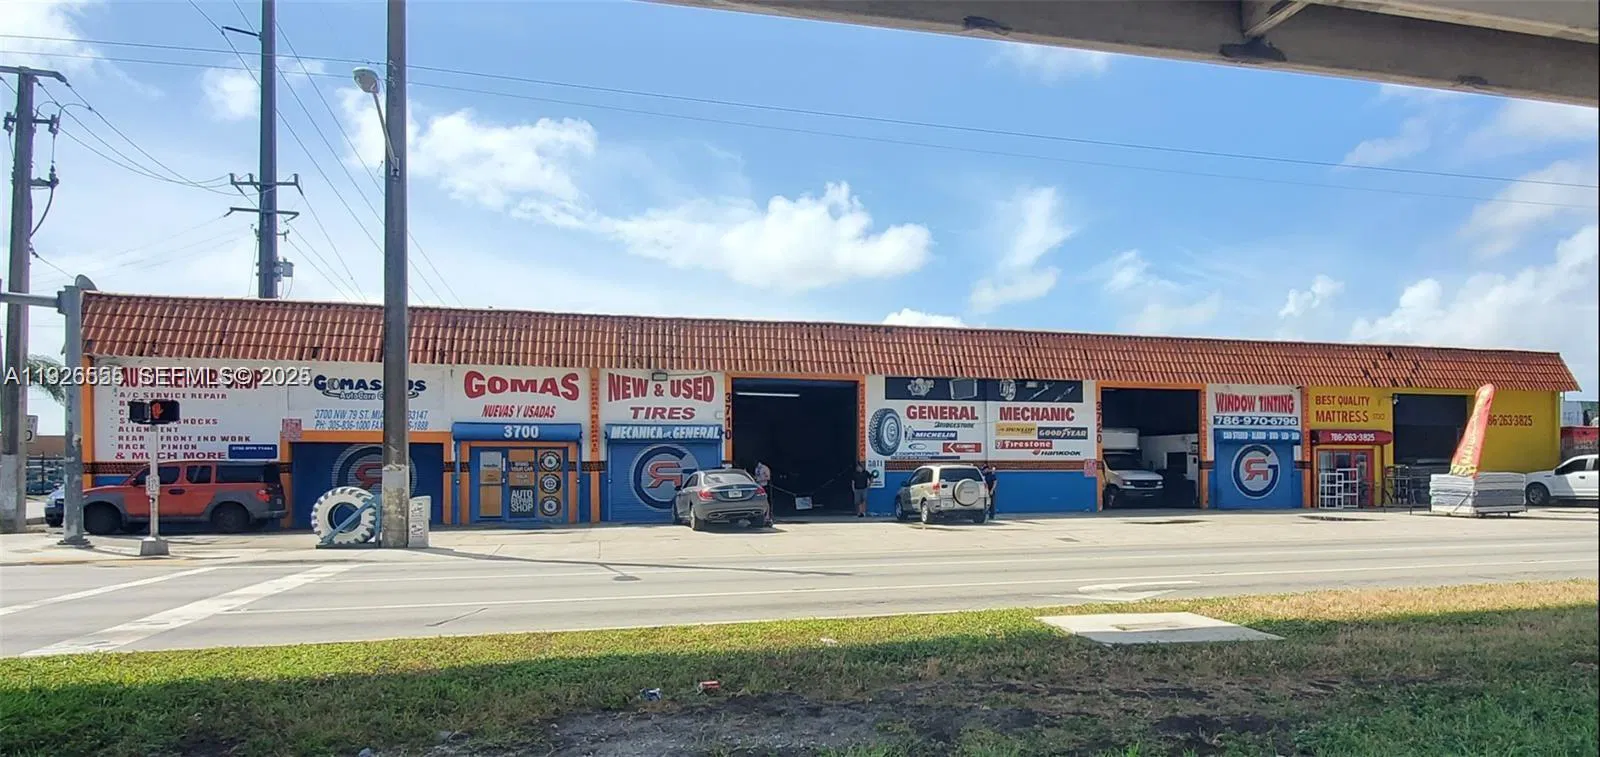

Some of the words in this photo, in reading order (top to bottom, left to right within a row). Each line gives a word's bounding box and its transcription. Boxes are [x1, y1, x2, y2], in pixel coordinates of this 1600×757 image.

[464, 370, 580, 401] GOMAS
[608, 372, 649, 402] NEW
[654, 383, 665, 398] &
[670, 375, 715, 403] USED
[1215, 392, 1256, 413] WINDOW
[1258, 394, 1294, 414] TINTING
[1315, 395, 1335, 406] BEST
[1338, 395, 1371, 407] QUALITY
[333, 409, 347, 419] NW
[481, 404, 514, 418] NUEVAS
[515, 405, 523, 418] Y
[523, 405, 556, 418] USADAS
[630, 406, 696, 420] TIRES
[906, 404, 979, 421] GENERAL
[1000, 406, 1075, 422] MECHANIC
[1315, 409, 1369, 423] MATTRESS
[1215, 416, 1297, 425] 786-970-6796
[1488, 414, 1533, 426] 86-263-3825
[504, 425, 539, 438] 3700
[611, 426, 663, 439] MECANICA
[672, 427, 720, 440] GENERAL
[1004, 440, 1051, 448] Firestone
[115, 451, 125, 460] &
[183, 451, 226, 460] MORE
[511, 489, 533, 500] AUTO
[511, 504, 533, 512] SHOP
